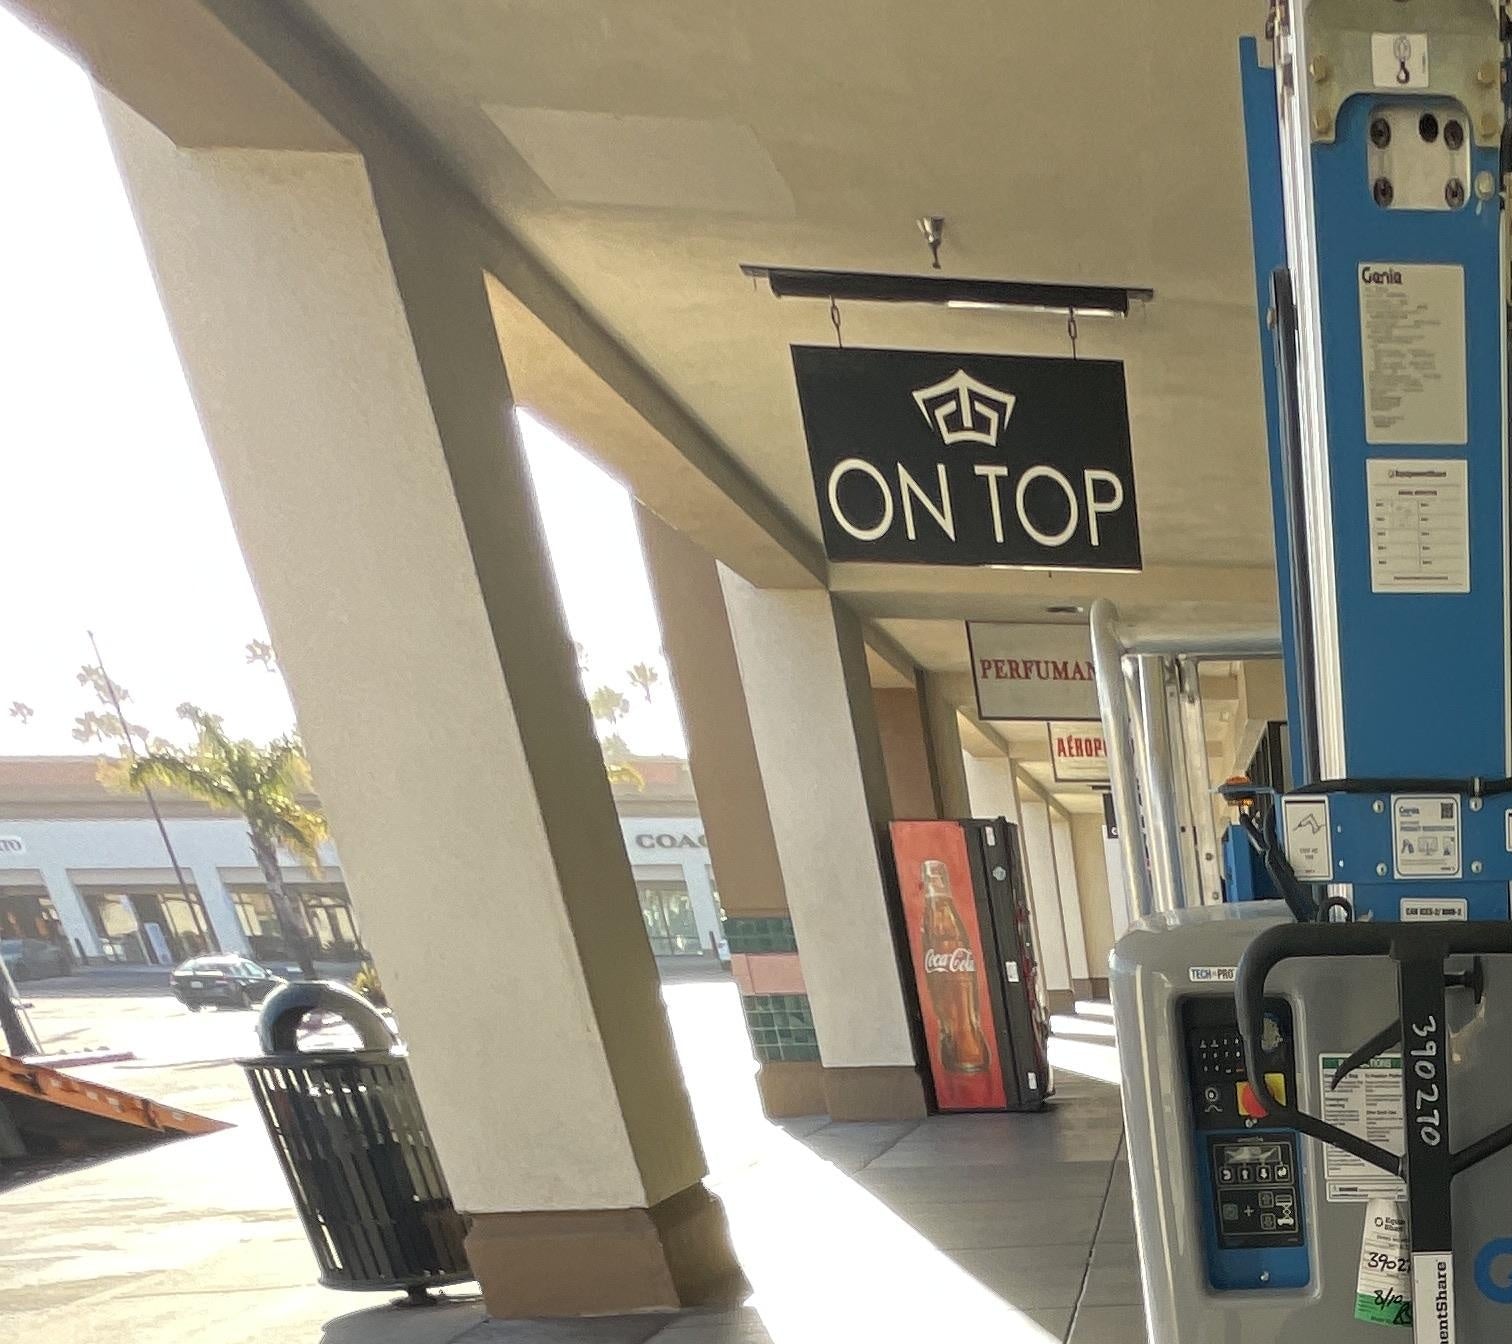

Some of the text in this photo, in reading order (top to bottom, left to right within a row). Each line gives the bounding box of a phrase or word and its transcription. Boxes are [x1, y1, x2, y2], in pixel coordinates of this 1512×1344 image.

[1362, 267, 1402, 284] Genie
[828, 458, 1123, 546] ON TOP
[1192, 968, 1234, 979] TECH PRO
[1410, 1014, 1441, 1148] 390270
